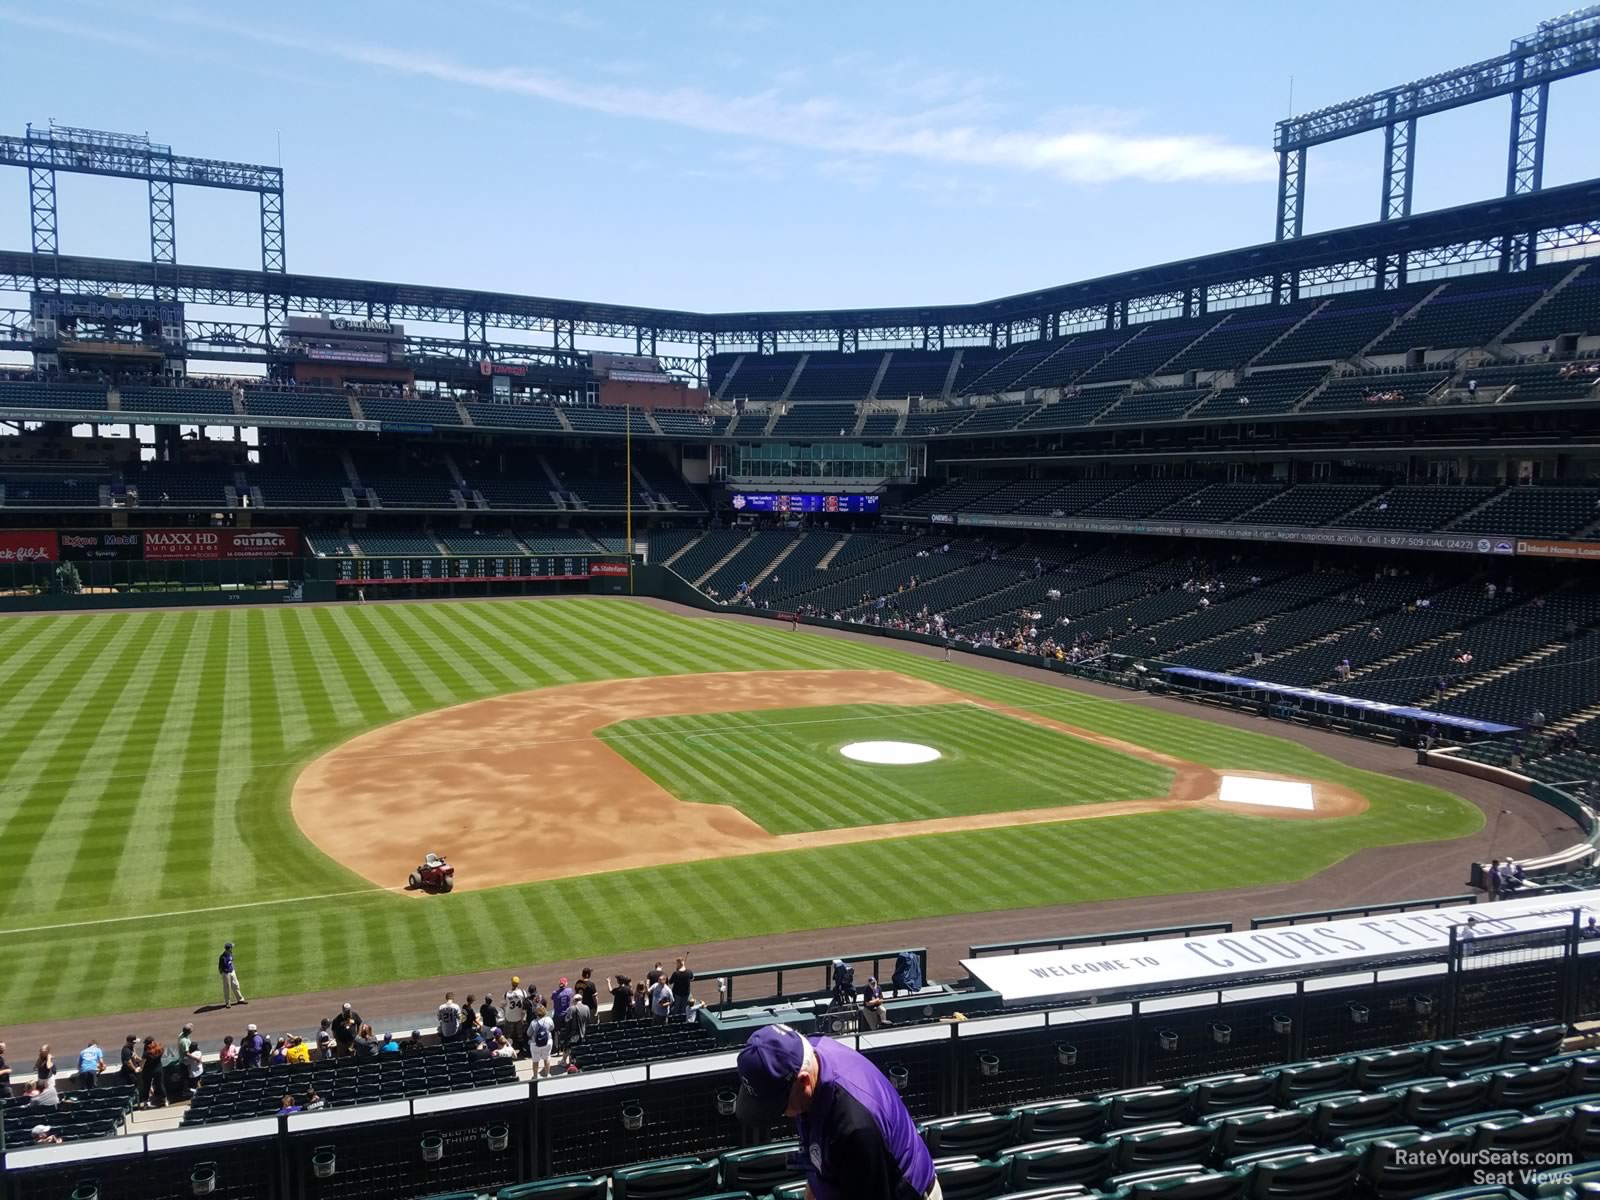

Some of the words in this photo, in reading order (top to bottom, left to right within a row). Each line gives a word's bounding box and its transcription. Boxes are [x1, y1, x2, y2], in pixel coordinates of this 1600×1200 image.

[61, 535, 98, 548] Exxon
[104, 534, 138, 545] Mobil
[145, 533, 193, 545] MAXX
[196, 533, 218, 545] HD
[233, 537, 287, 547] OUTBACK
[1277, 532, 1300, 541] Report
[1301, 532, 1335, 542] suspicious
[1367, 535, 1381, 544] Call
[1383, 536, 1445, 548] 1-877-509-CIAC
[1446, 539, 1474, 550] (2422)
[95, 550, 118, 558] Synergy
[146, 544, 219, 553] sunglasses
[1028, 958, 1130, 979] WELCOME
[1129, 955, 1161, 968] TO
[1184, 926, 1367, 967] COORS
[509, 1000, 522, 1010] 34
[443, 1012, 454, 1023] 21
[444, 1135, 477, 1145] THIRD
